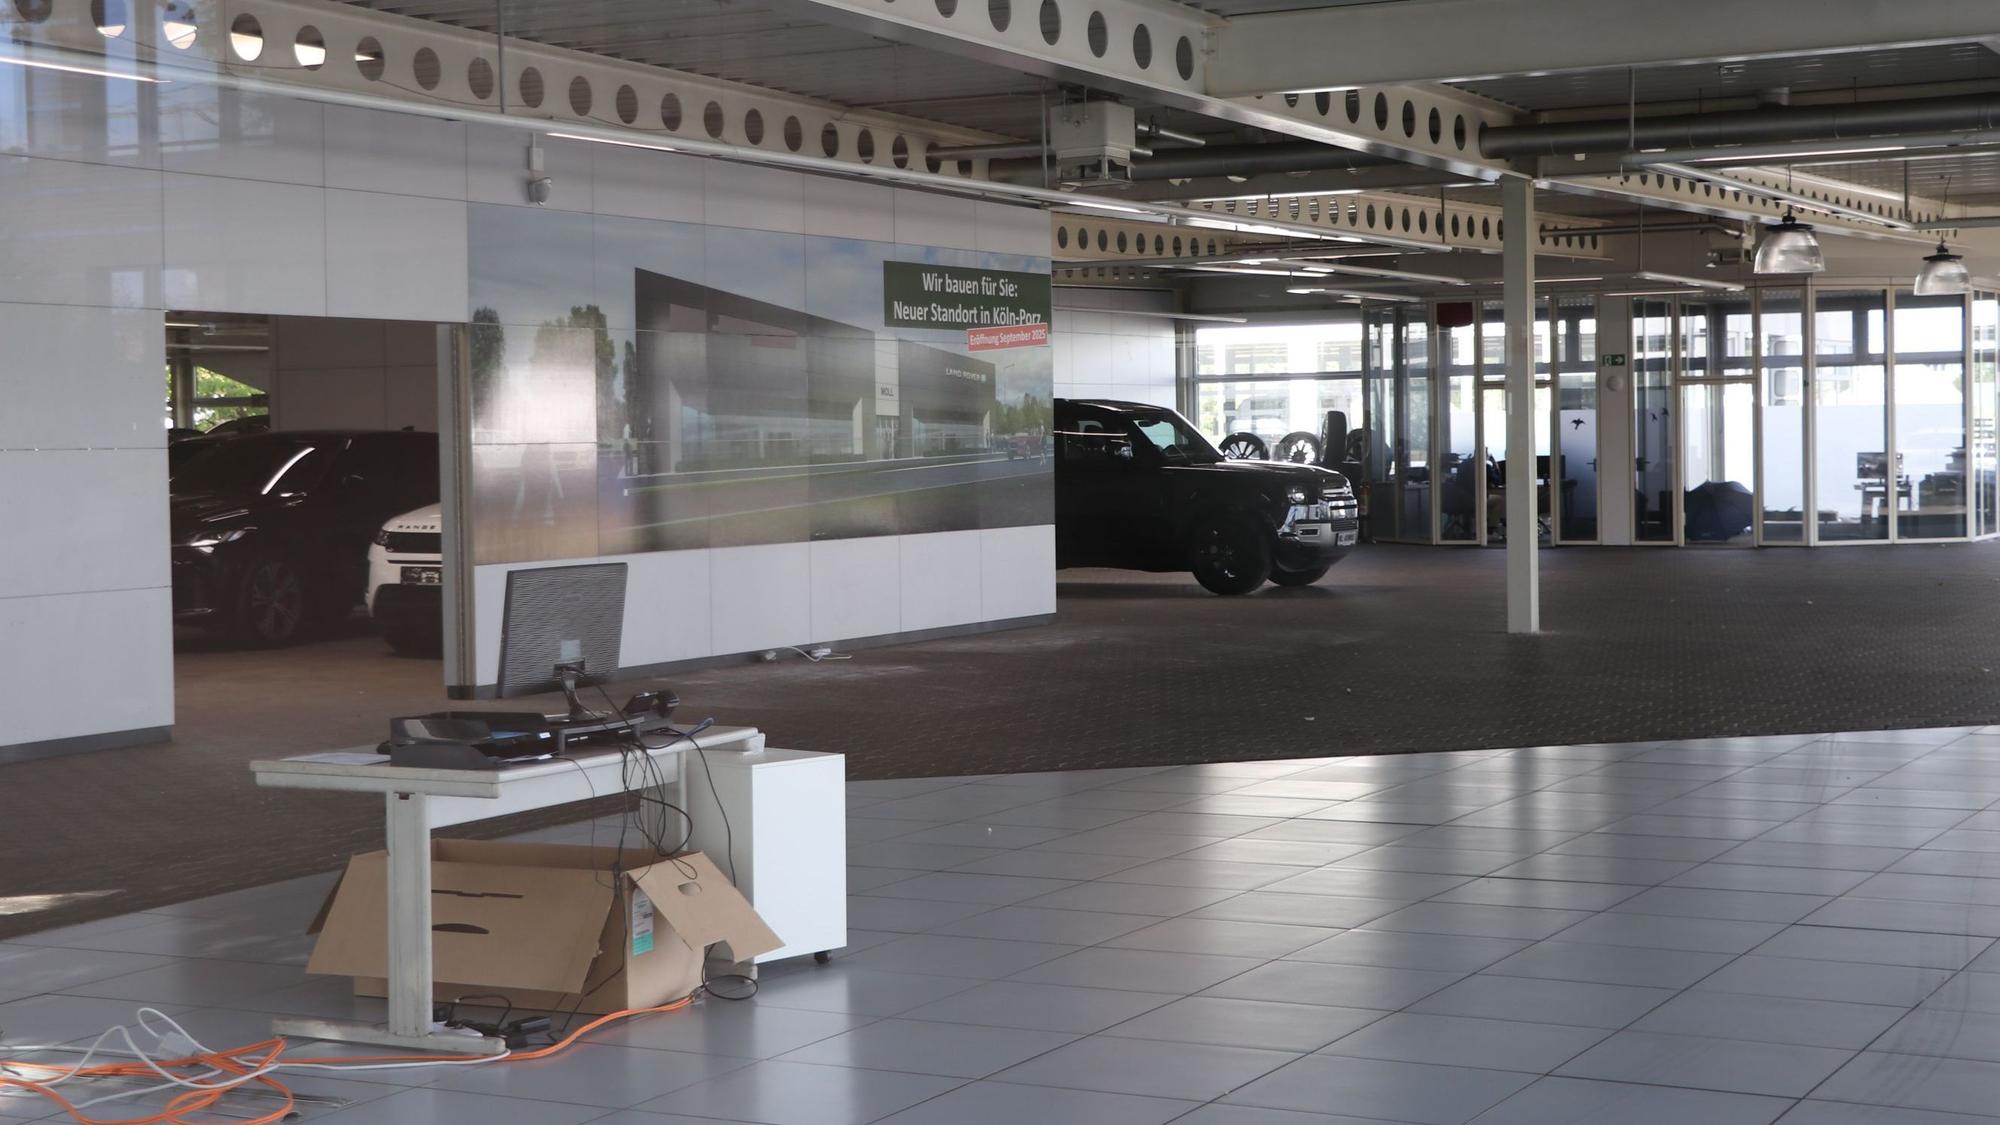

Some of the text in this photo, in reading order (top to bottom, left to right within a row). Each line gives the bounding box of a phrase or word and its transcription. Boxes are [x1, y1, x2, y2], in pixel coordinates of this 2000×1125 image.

[922, 272, 1018, 297] Wir bauen für Sie:
[893, 301, 1041, 325] Neuer Standort in Köln-Porz
[970, 328, 1046, 346] Eröffnung September 2025
